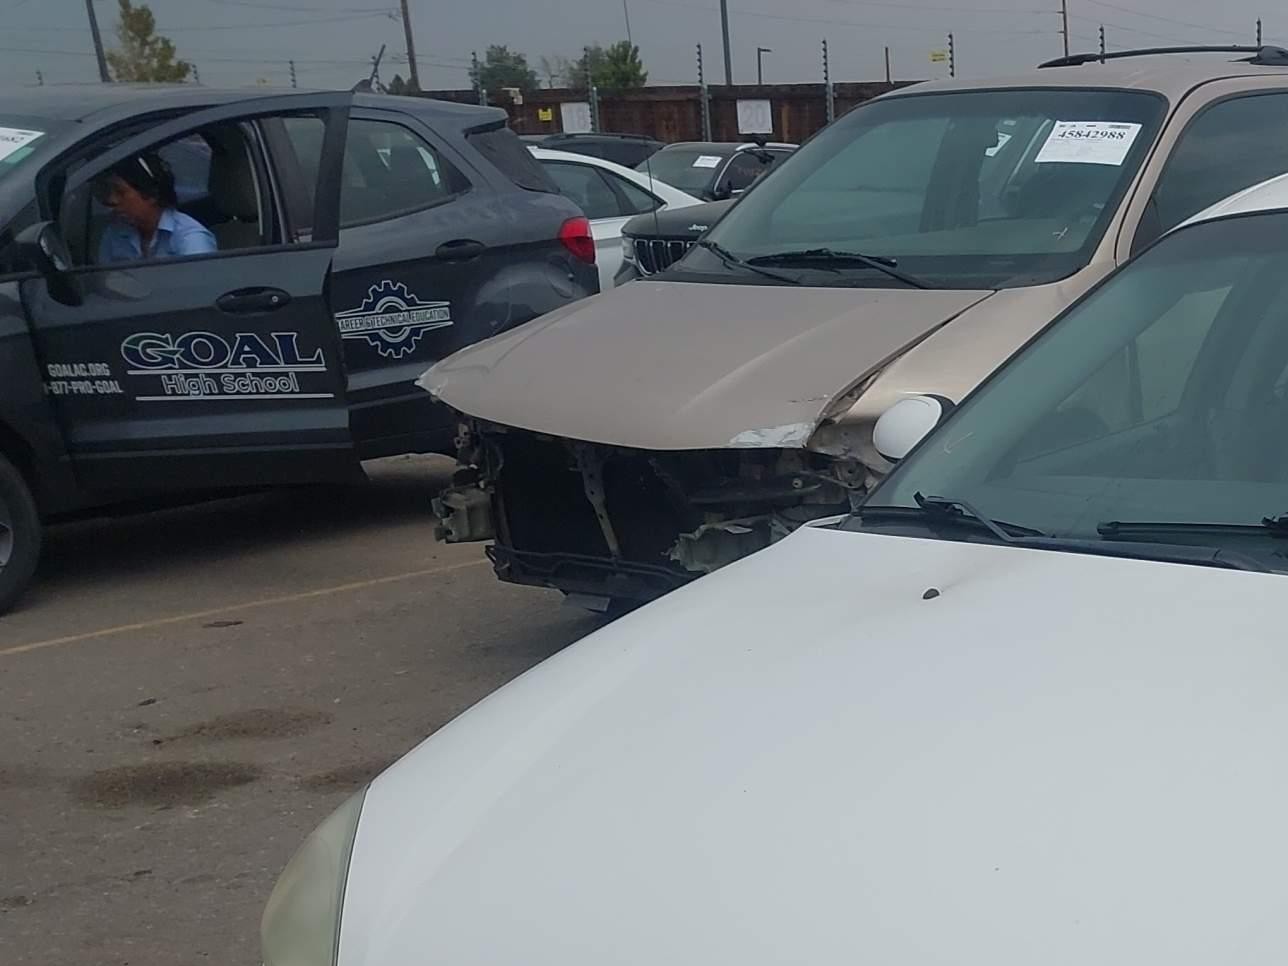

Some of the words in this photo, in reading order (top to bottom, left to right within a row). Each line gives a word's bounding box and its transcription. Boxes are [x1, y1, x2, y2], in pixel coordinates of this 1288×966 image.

[742, 103, 766, 128] 20
[1057, 129, 1127, 140] 45842988
[687, 223, 708, 232] Jeep
[339, 317, 364, 330] AREER
[120, 331, 326, 369] GOAL
[47, 362, 111, 378] GOALAC.ORG
[161, 373, 219, 397] High
[223, 372, 300, 394] School
